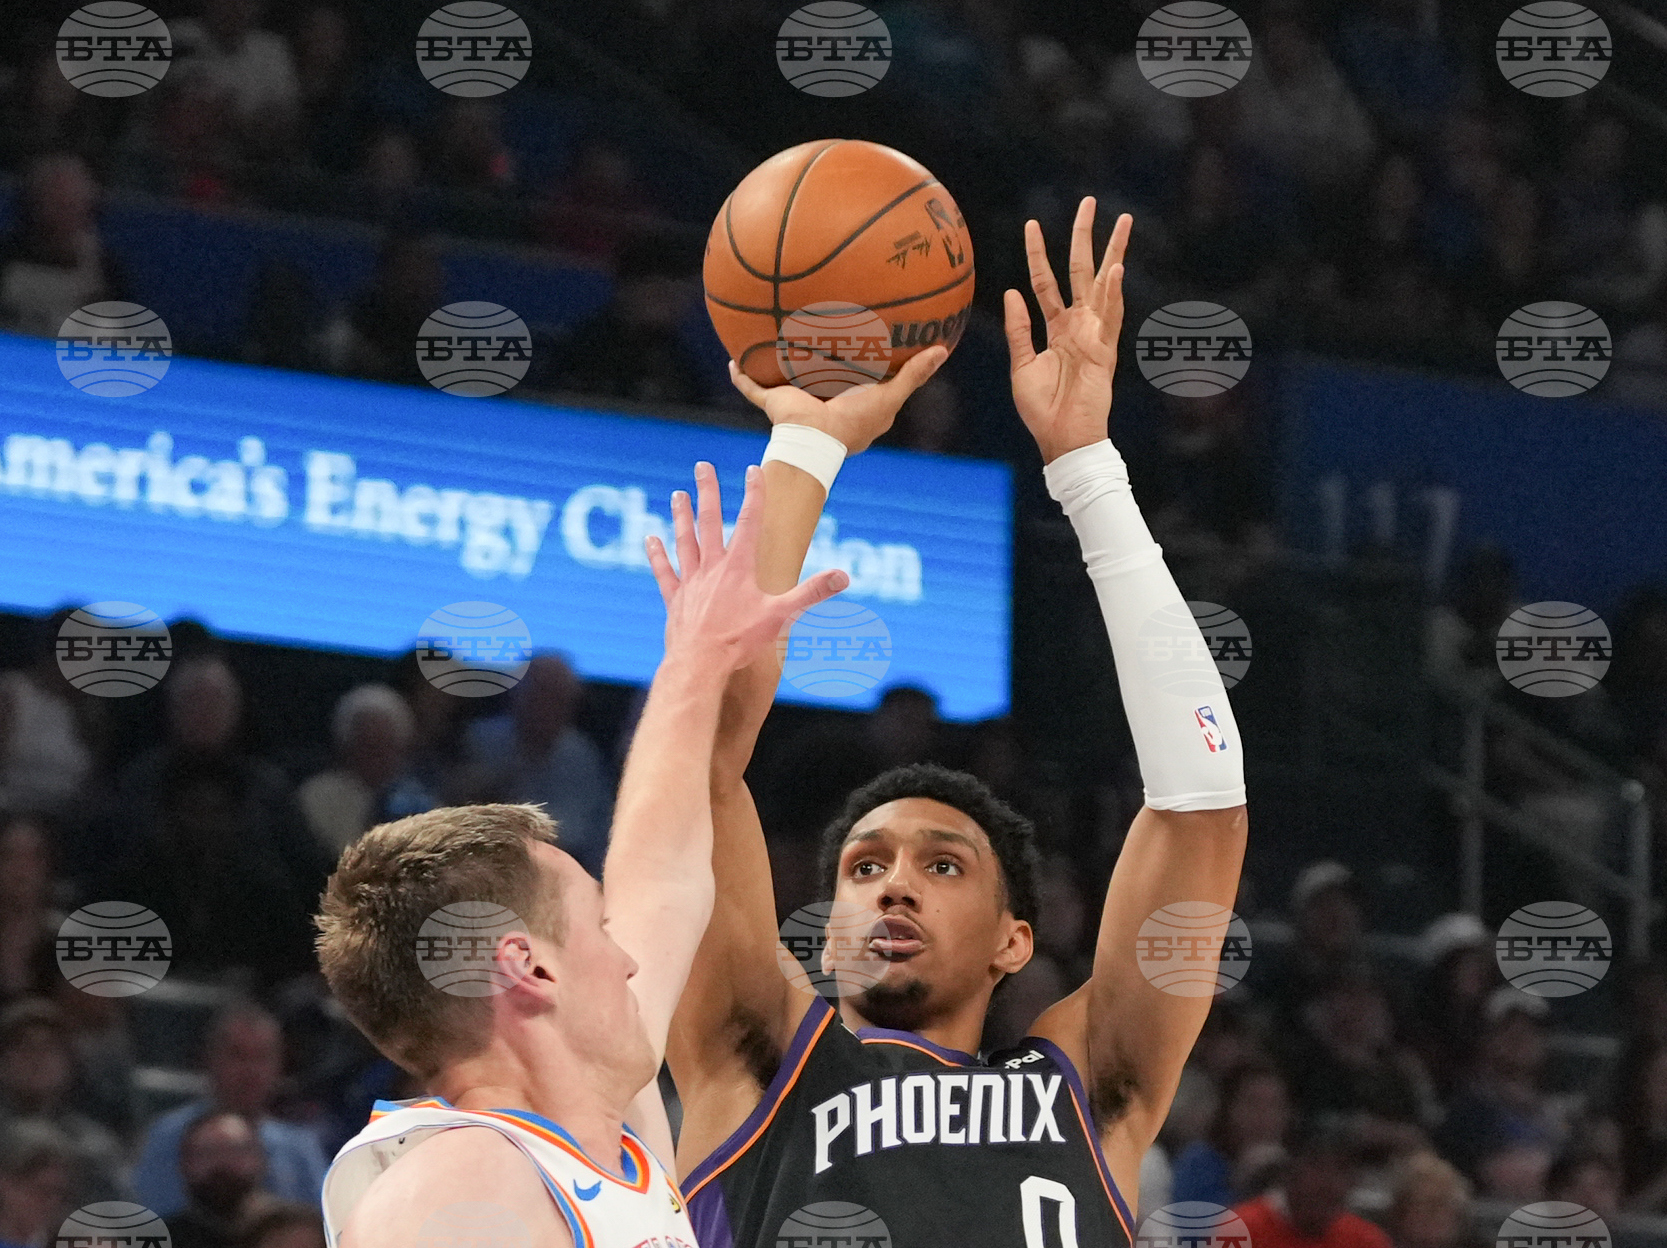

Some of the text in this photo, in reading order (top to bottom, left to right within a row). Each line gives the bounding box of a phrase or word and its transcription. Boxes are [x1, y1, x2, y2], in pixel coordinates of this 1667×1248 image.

[0, 431, 923, 603] merica's Energy Chion
[1004, 1049, 1045, 1069] Pal
[811, 1073, 1067, 1175] PHOENIX
